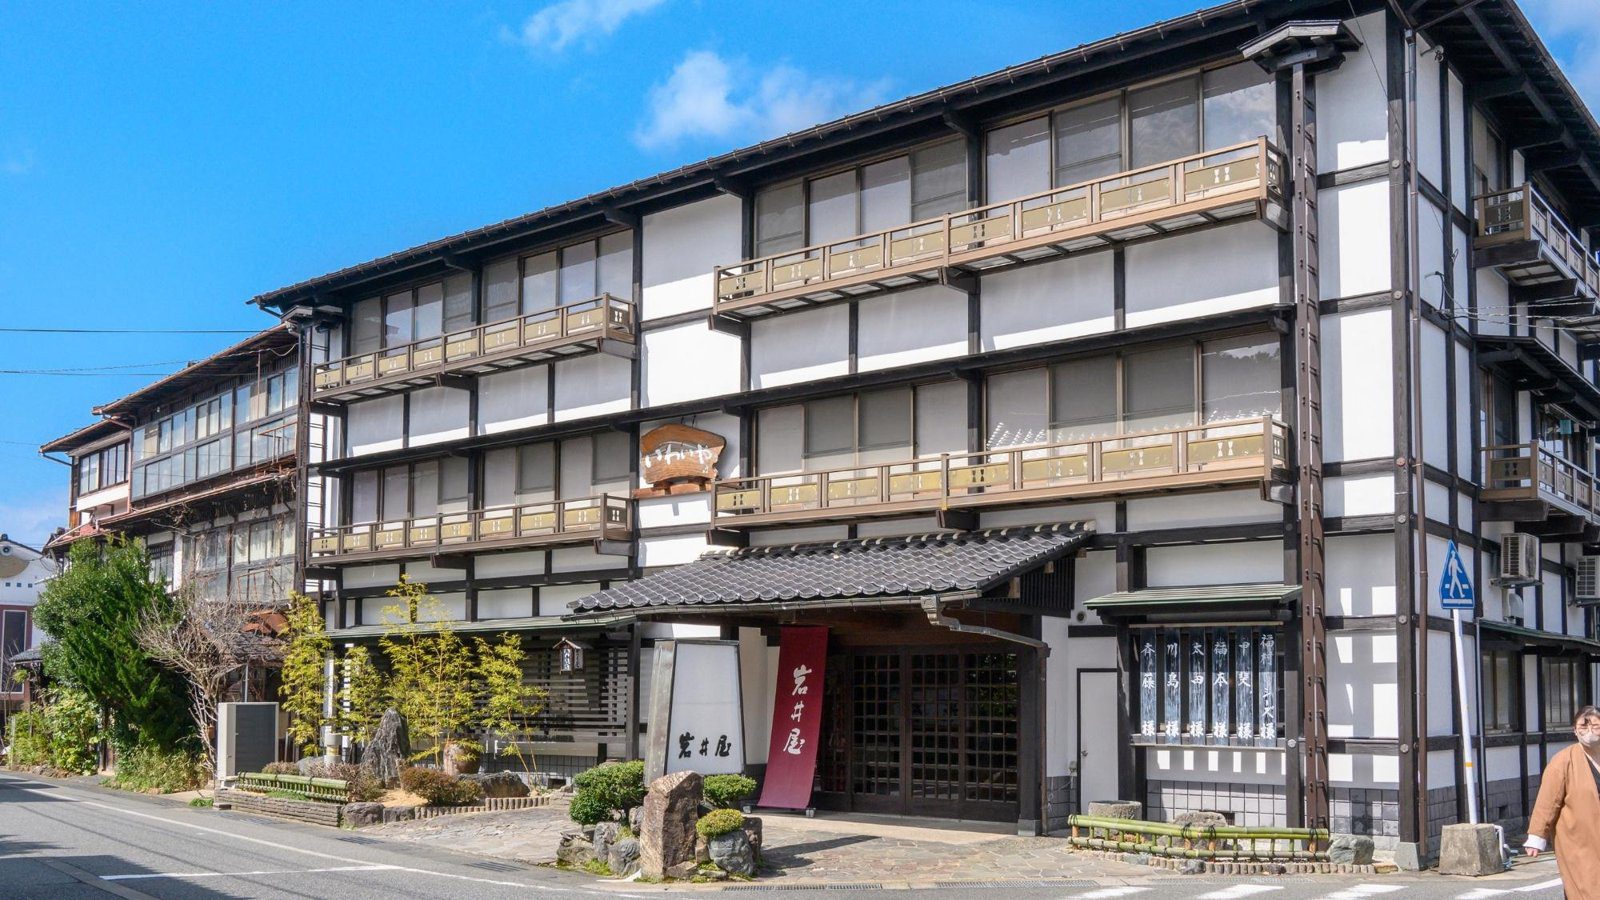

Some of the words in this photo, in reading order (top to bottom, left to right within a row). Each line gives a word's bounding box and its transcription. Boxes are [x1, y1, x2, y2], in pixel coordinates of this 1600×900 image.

[783, 664, 812, 755] 岩井屋
[678, 731, 732, 759] 岩井屋
